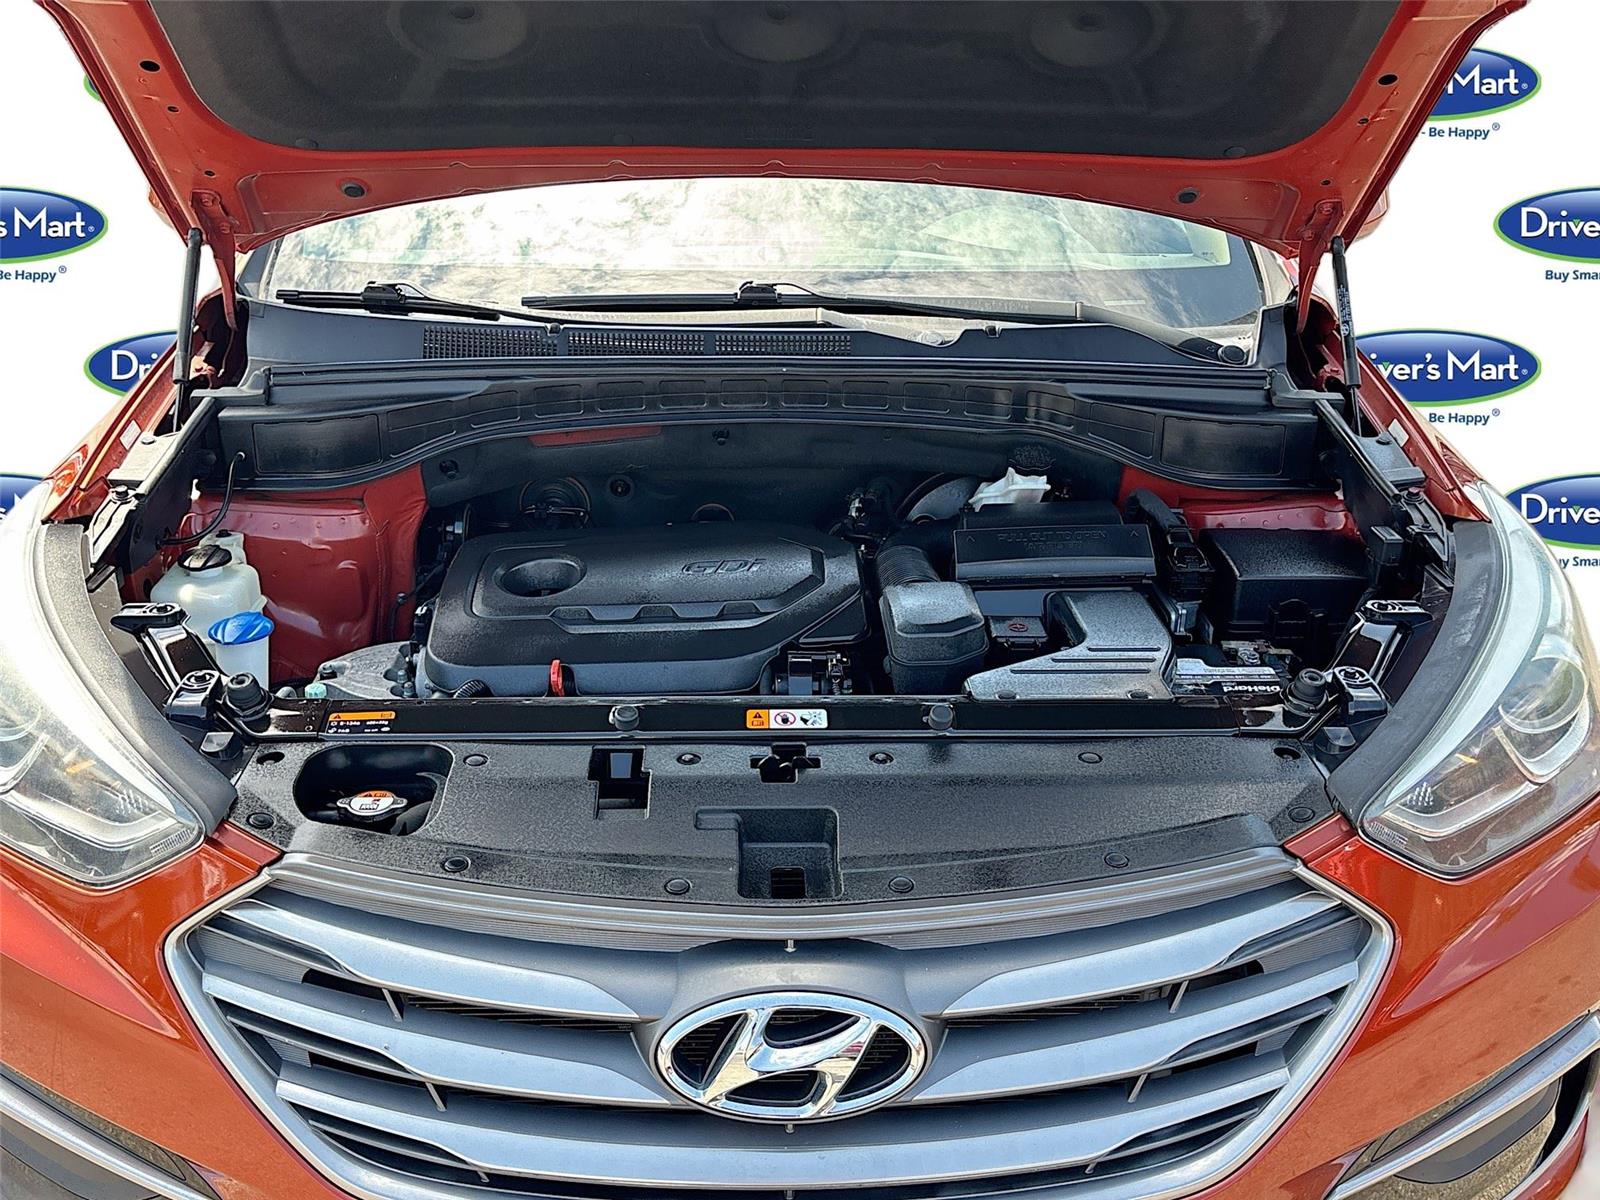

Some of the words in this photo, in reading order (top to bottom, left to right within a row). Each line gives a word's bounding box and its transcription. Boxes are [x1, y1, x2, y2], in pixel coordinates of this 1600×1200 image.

[1429, 127, 1445, 138] Be
[1545, 269, 1570, 283] Buy
[1429, 412, 1445, 424] Be
[1222, 684, 1281, 693] DieHard
